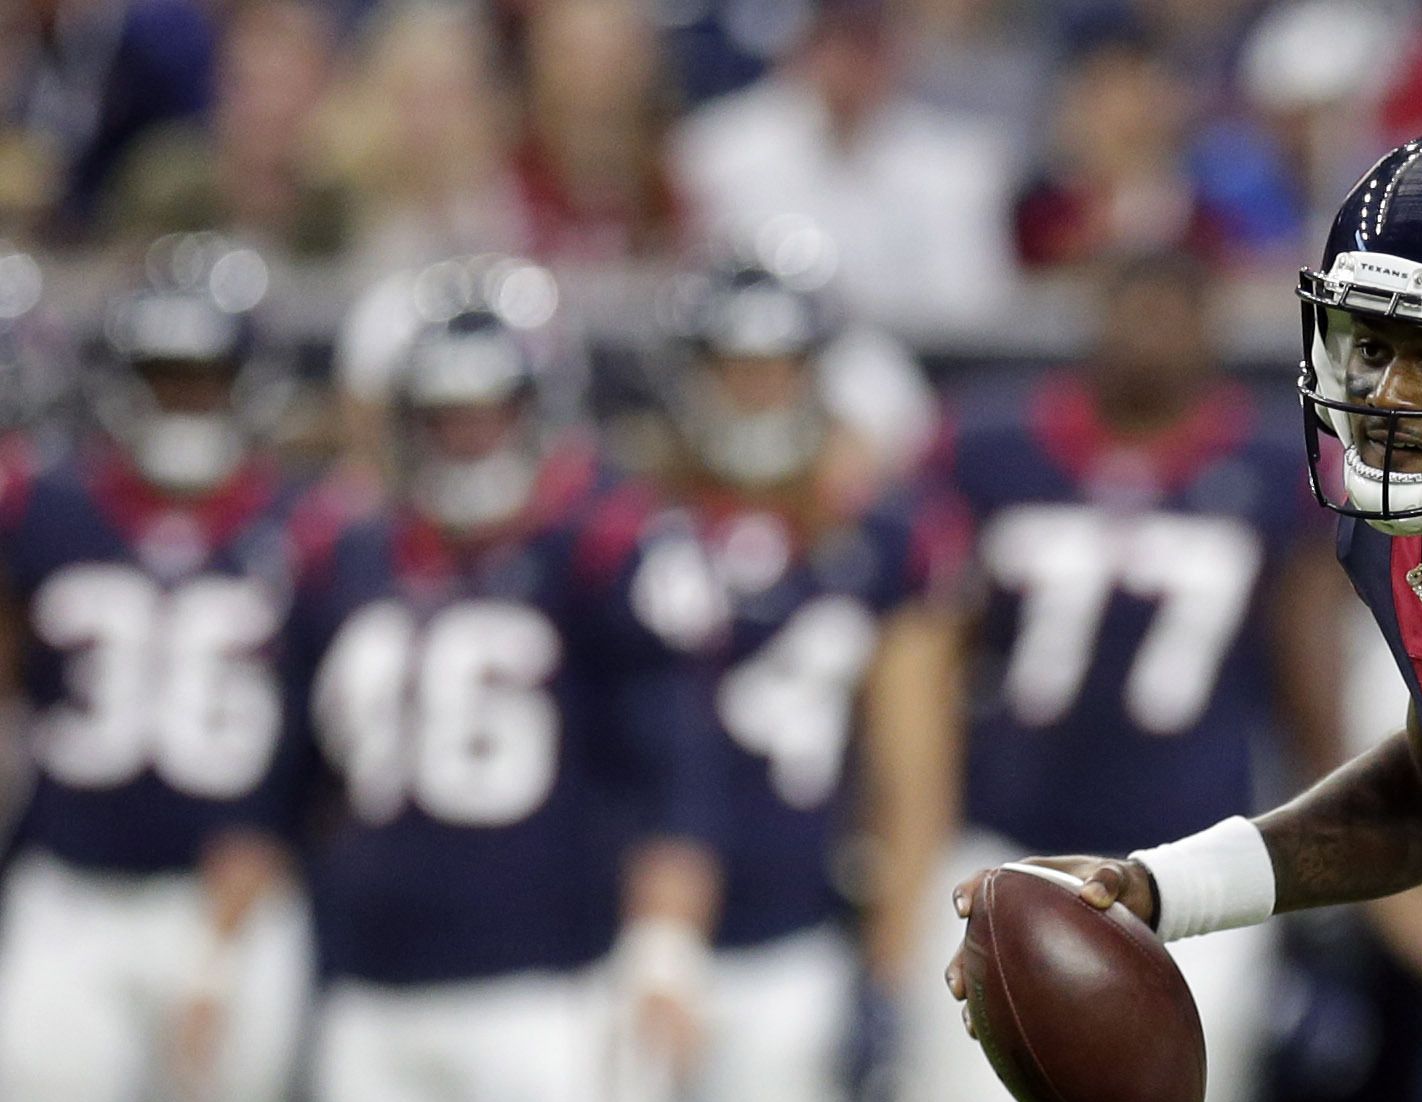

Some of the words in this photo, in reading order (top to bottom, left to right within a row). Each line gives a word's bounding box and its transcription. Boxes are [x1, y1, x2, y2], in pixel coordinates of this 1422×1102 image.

[1361, 262, 1408, 279] TEXANS
[30, 562, 284, 798] 36
[980, 502, 1263, 736] 77
